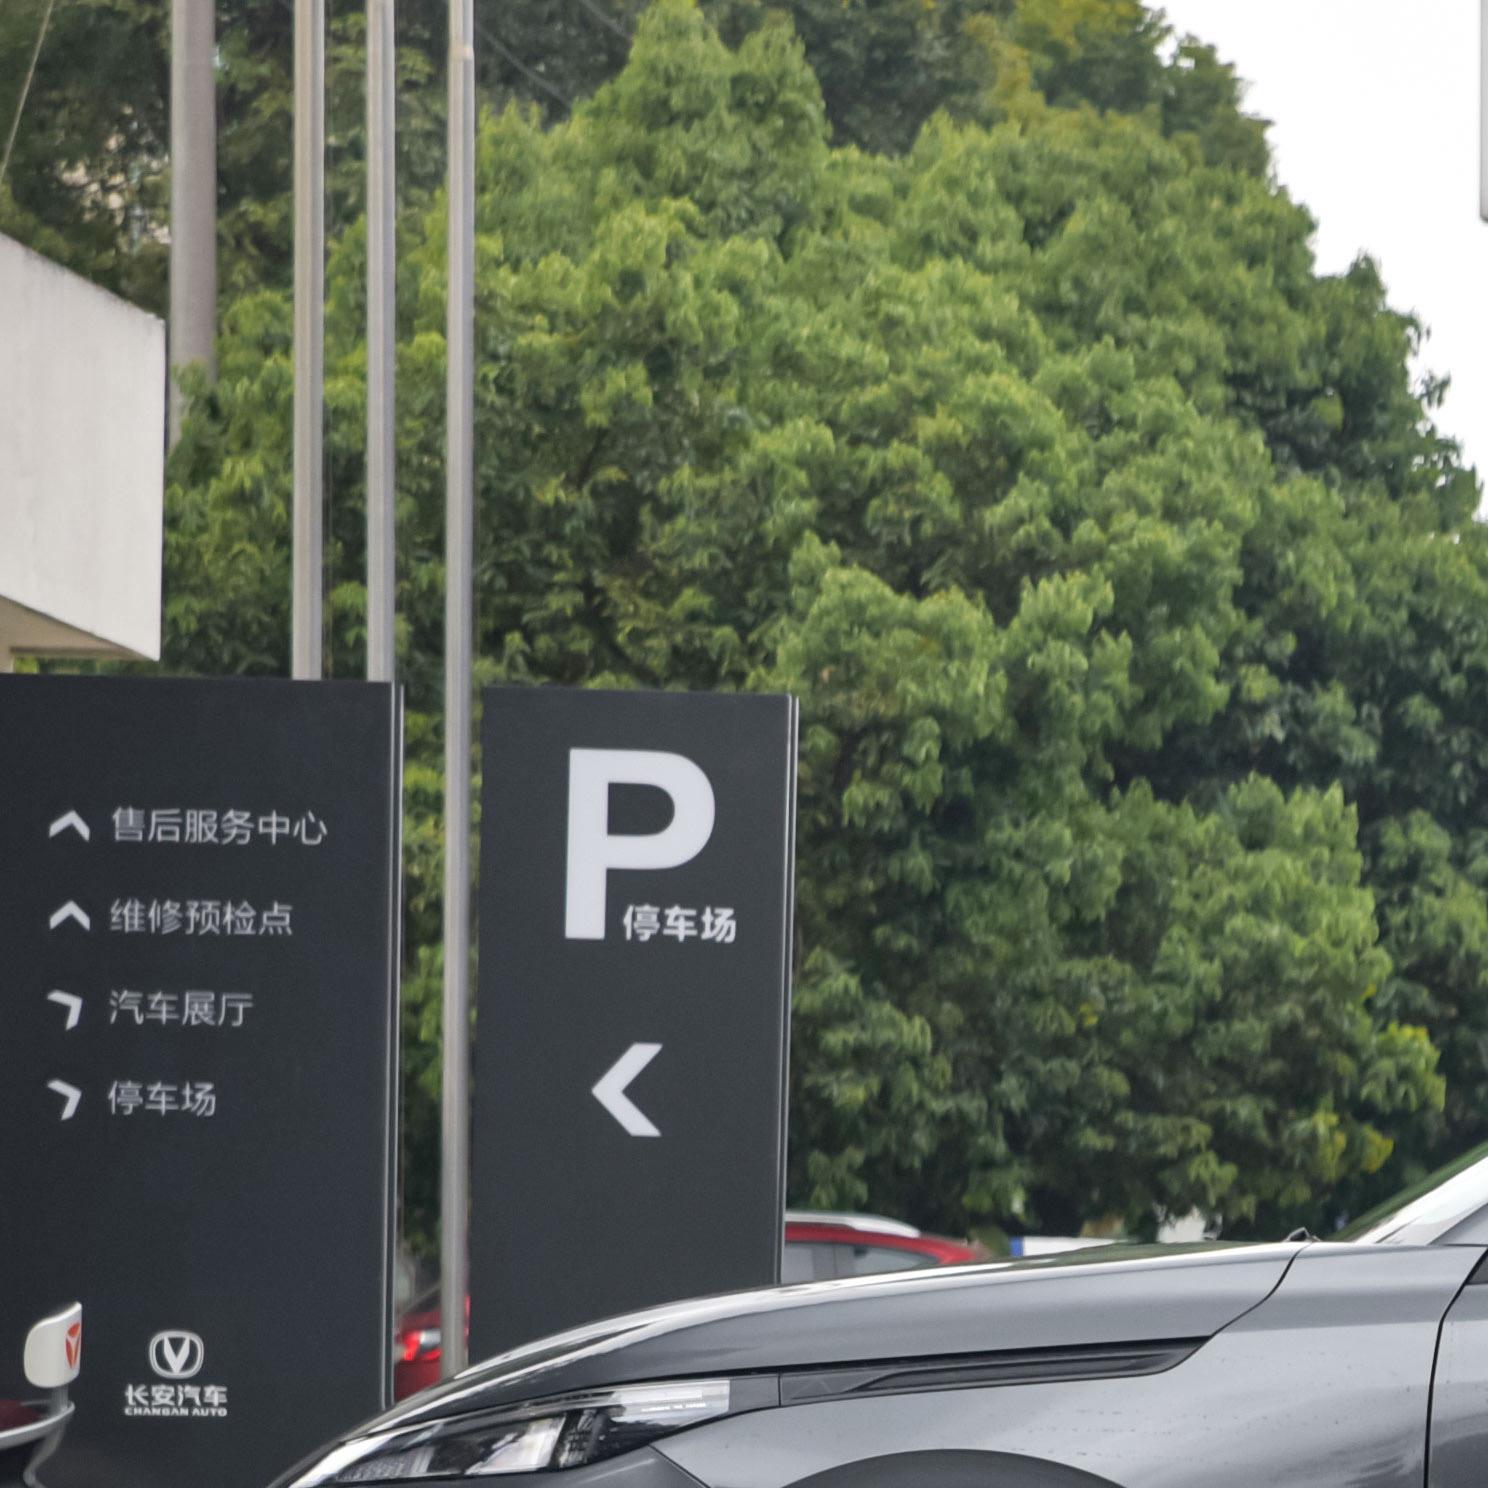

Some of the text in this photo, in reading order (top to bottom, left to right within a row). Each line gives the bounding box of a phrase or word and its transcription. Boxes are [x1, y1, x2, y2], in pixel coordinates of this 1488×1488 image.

[111, 808, 328, 845] 售后服务中心
[564, 747, 716, 940] P
[109, 899, 294, 936] 维修预检点
[623, 905, 737, 943] 停车场
[108, 989, 255, 1028] 汽车展厅
[107, 1081, 218, 1116] 停车场
[124, 1383, 228, 1406] 长安汽车
[124, 1407, 228, 1417] CHANGAN AUTO
